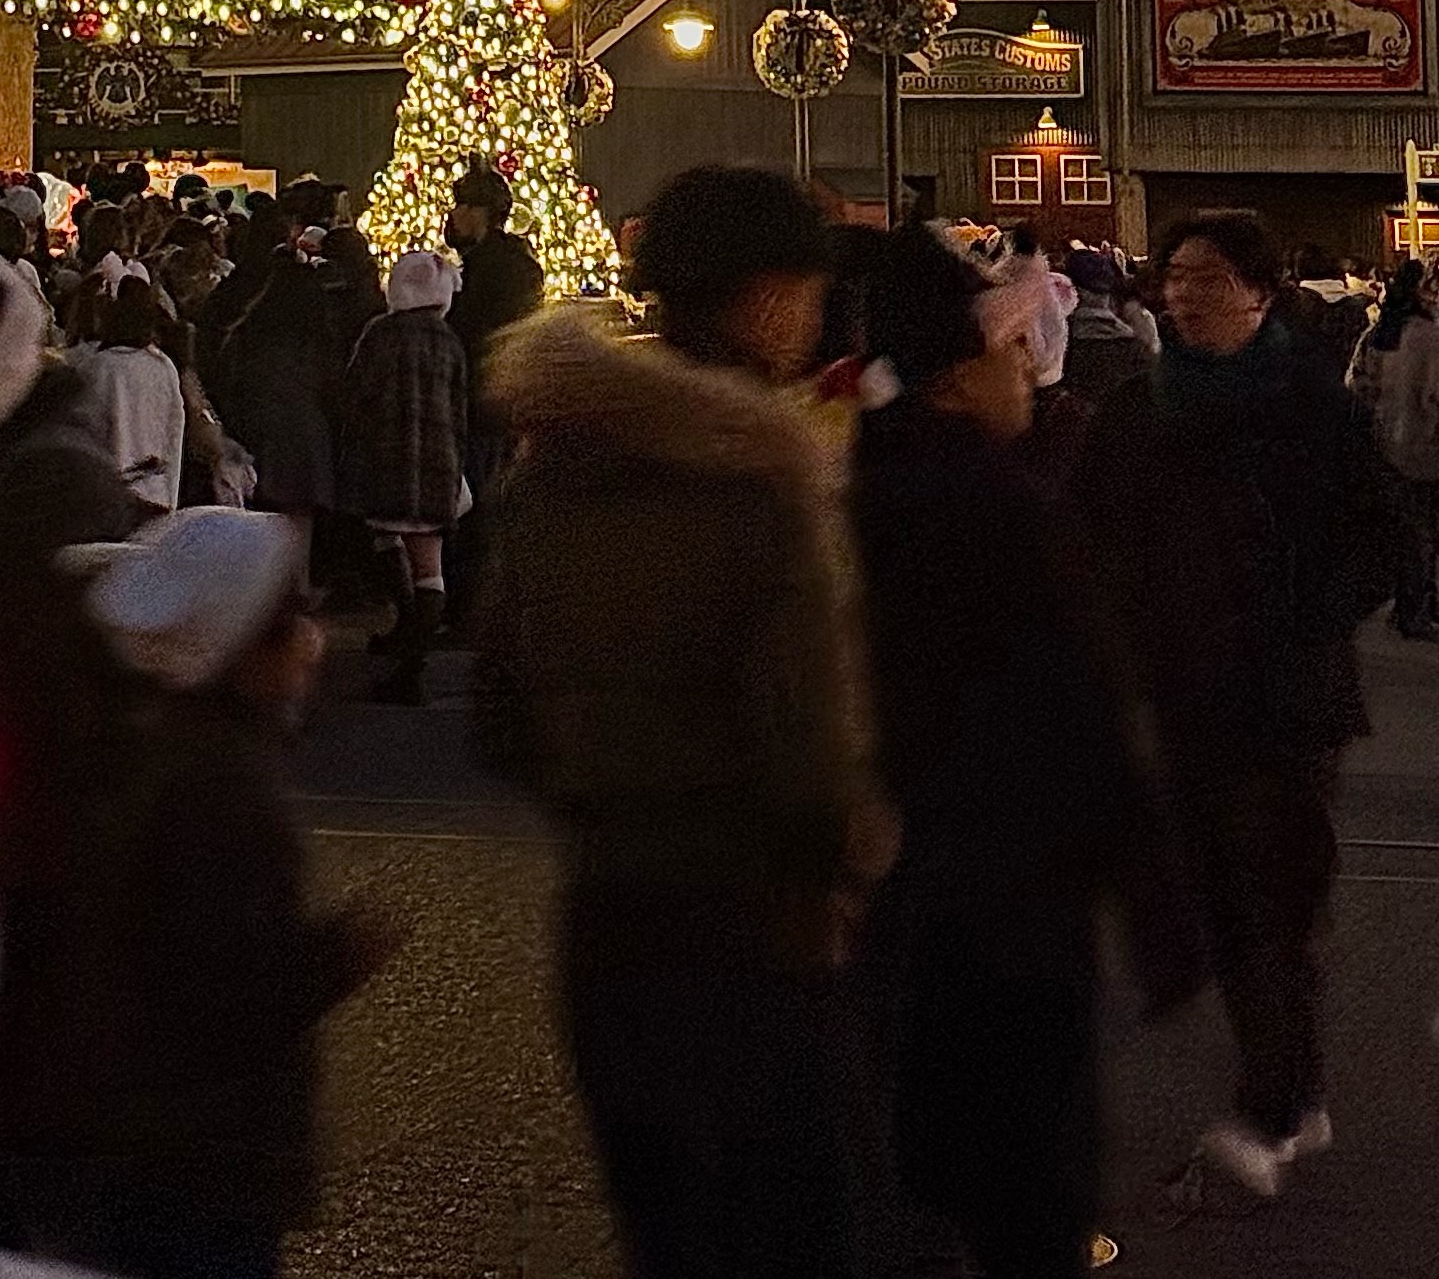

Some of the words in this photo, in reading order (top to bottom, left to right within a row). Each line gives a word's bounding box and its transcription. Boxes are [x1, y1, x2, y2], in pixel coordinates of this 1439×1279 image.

[928, 36, 991, 61] STATES
[993, 39, 1072, 73] CUSTOMS
[975, 74, 1068, 91] STORAGE
